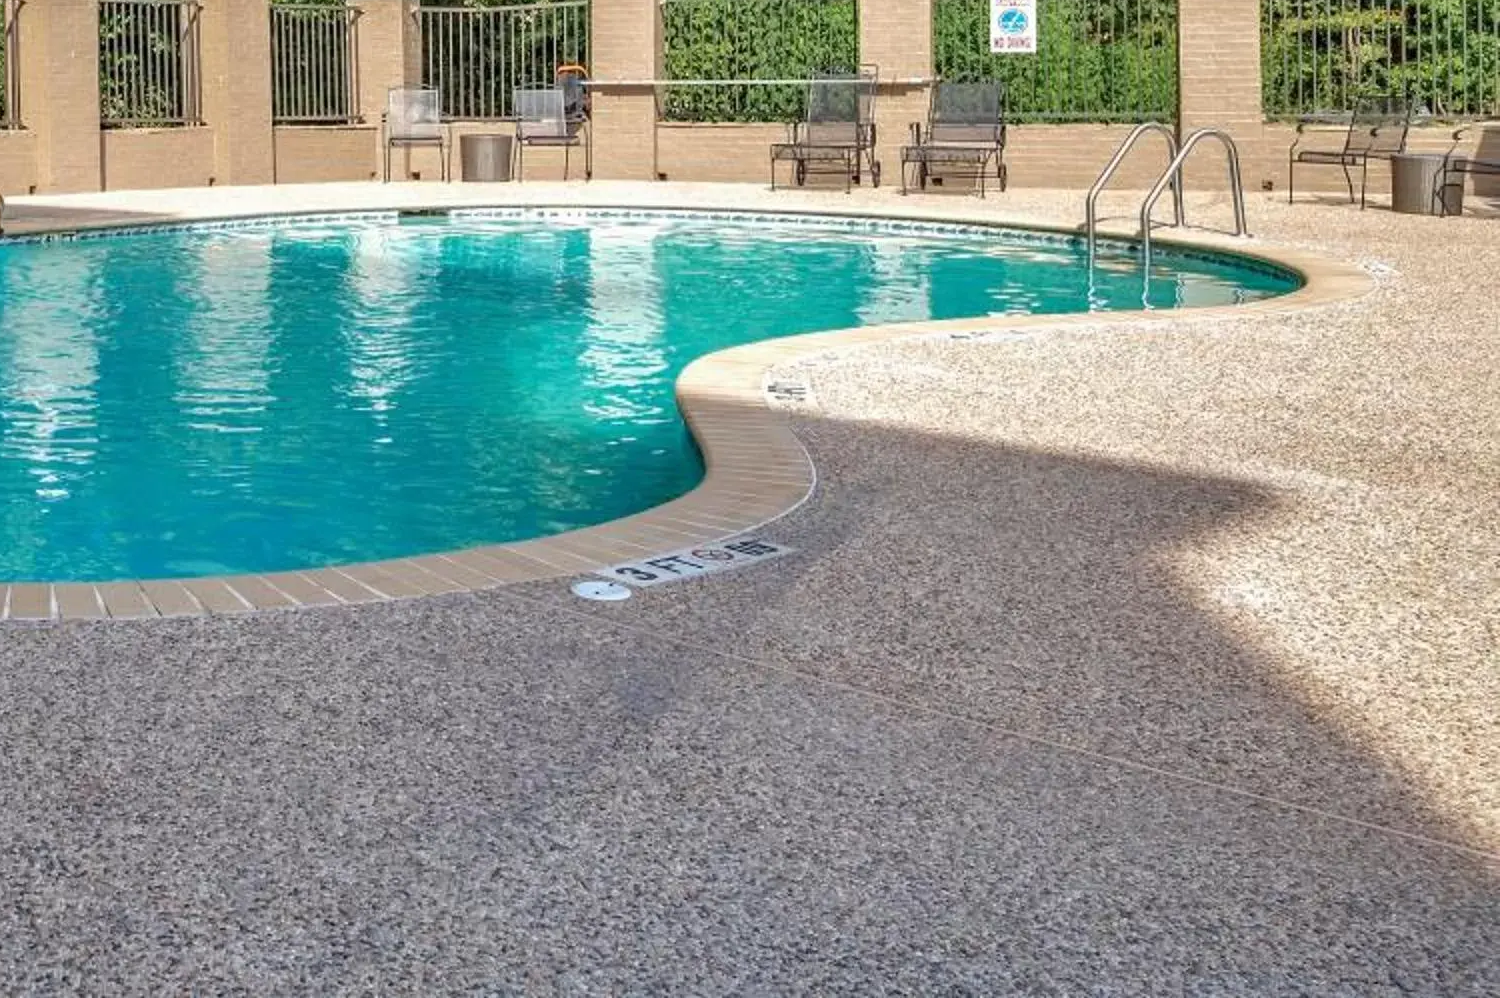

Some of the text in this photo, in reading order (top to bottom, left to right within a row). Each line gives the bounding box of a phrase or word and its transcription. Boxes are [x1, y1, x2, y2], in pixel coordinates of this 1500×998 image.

[994, 37, 1004, 48] NO
[615, 555, 704, 581] 3 FT
